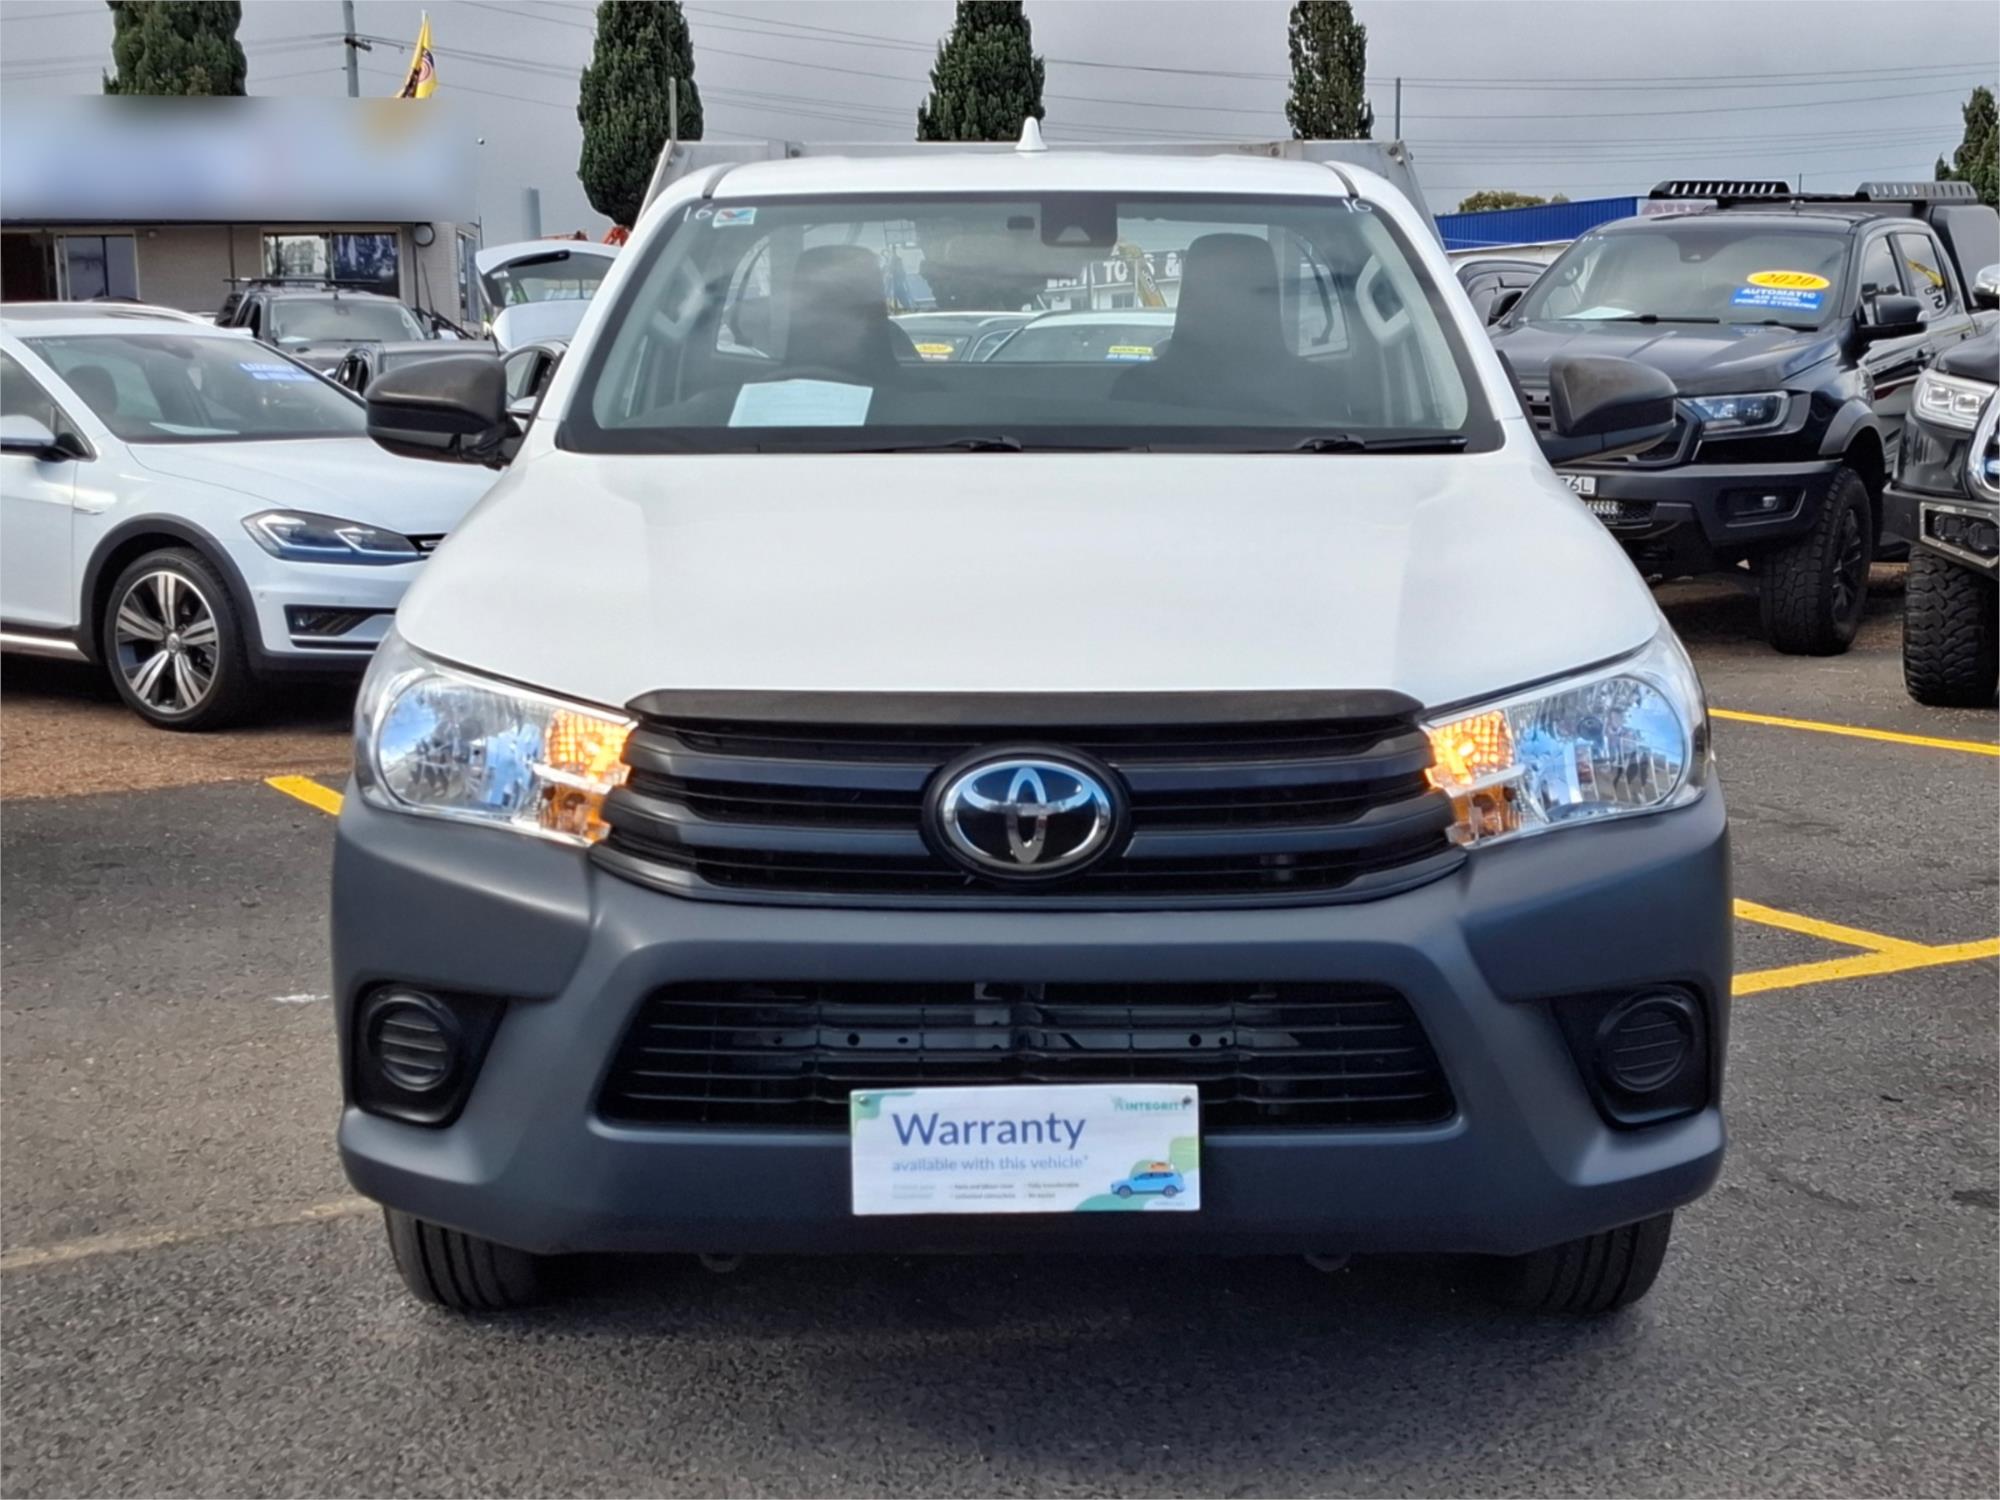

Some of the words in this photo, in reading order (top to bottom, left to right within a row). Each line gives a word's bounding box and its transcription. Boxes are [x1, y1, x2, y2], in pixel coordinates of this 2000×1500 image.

[1741, 288, 1817, 299] AUTOMATIC
[892, 1112, 1086, 1150] Warranty
[892, 1157, 957, 1171] available
[961, 1157, 995, 1170] with
[999, 1156, 1026, 1169] this
